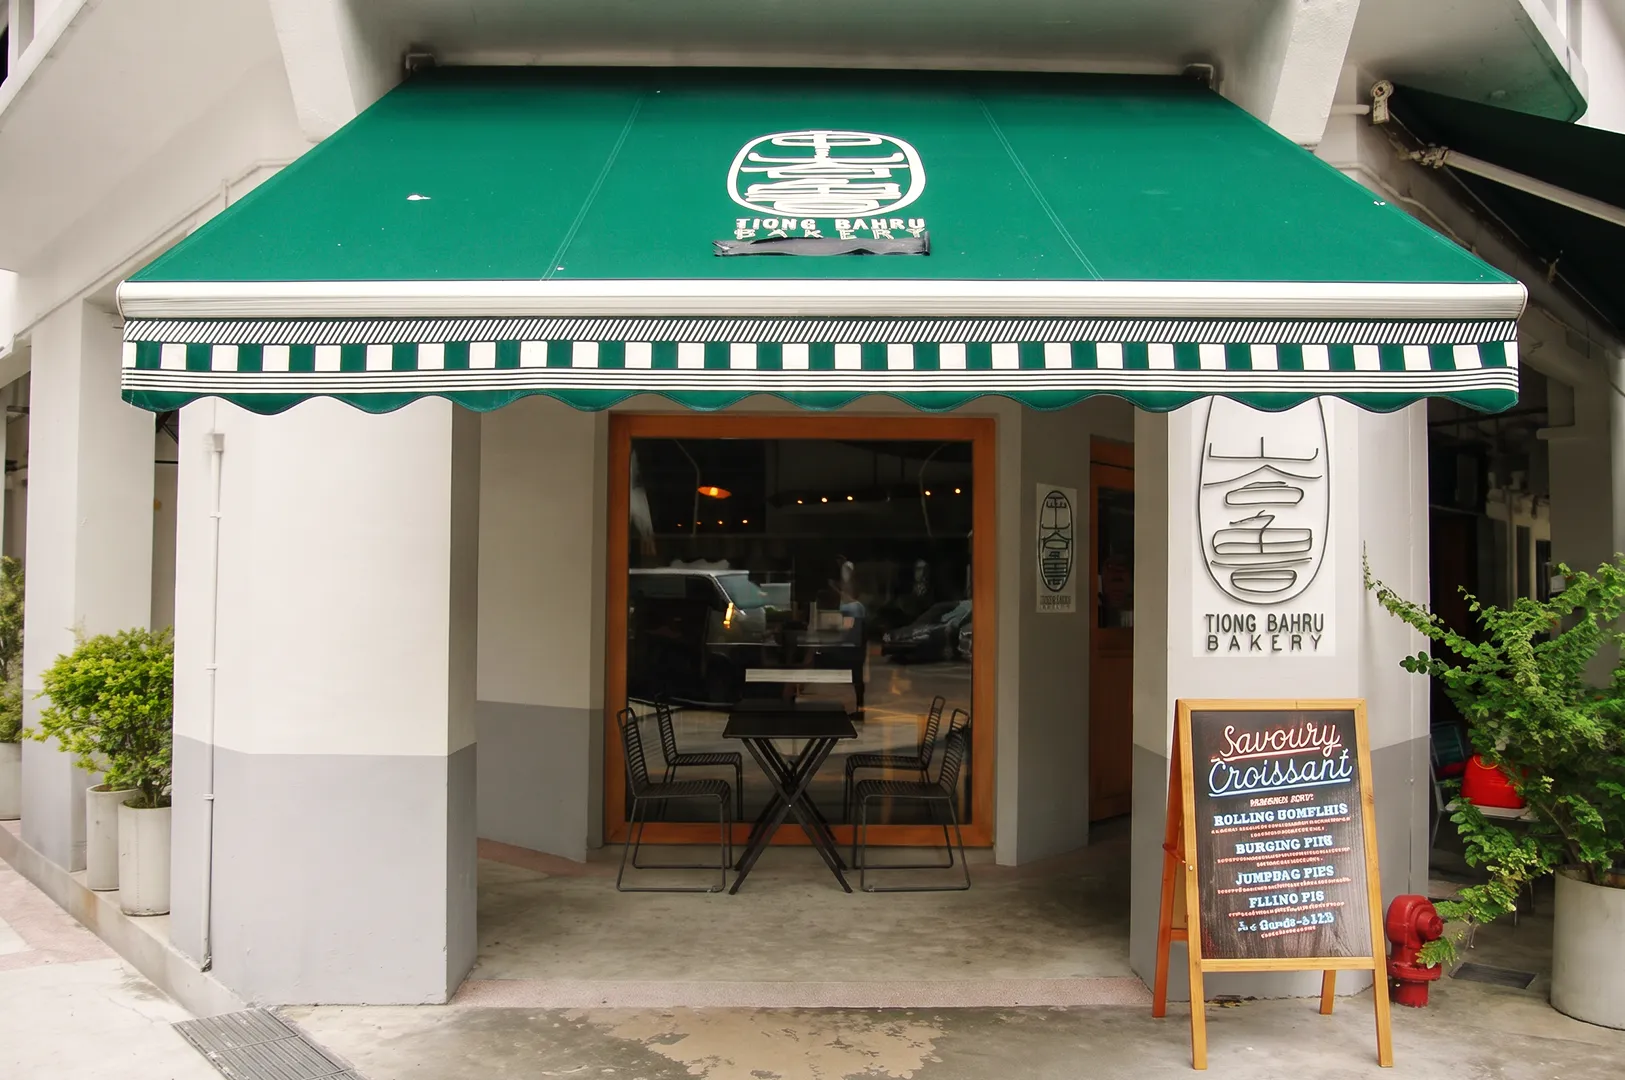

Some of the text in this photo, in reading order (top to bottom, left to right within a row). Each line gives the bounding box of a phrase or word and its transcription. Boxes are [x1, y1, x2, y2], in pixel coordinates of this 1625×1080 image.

[736, 218, 925, 230] TIONG BAHRU
[1204, 613, 1324, 633] TIONG BAHRU
[1206, 634, 1322, 651] BAKERY
[1219, 722, 1341, 757] Savoury
[1209, 749, 1353, 794] Croissant
[1235, 839, 1301, 854] BURGING
